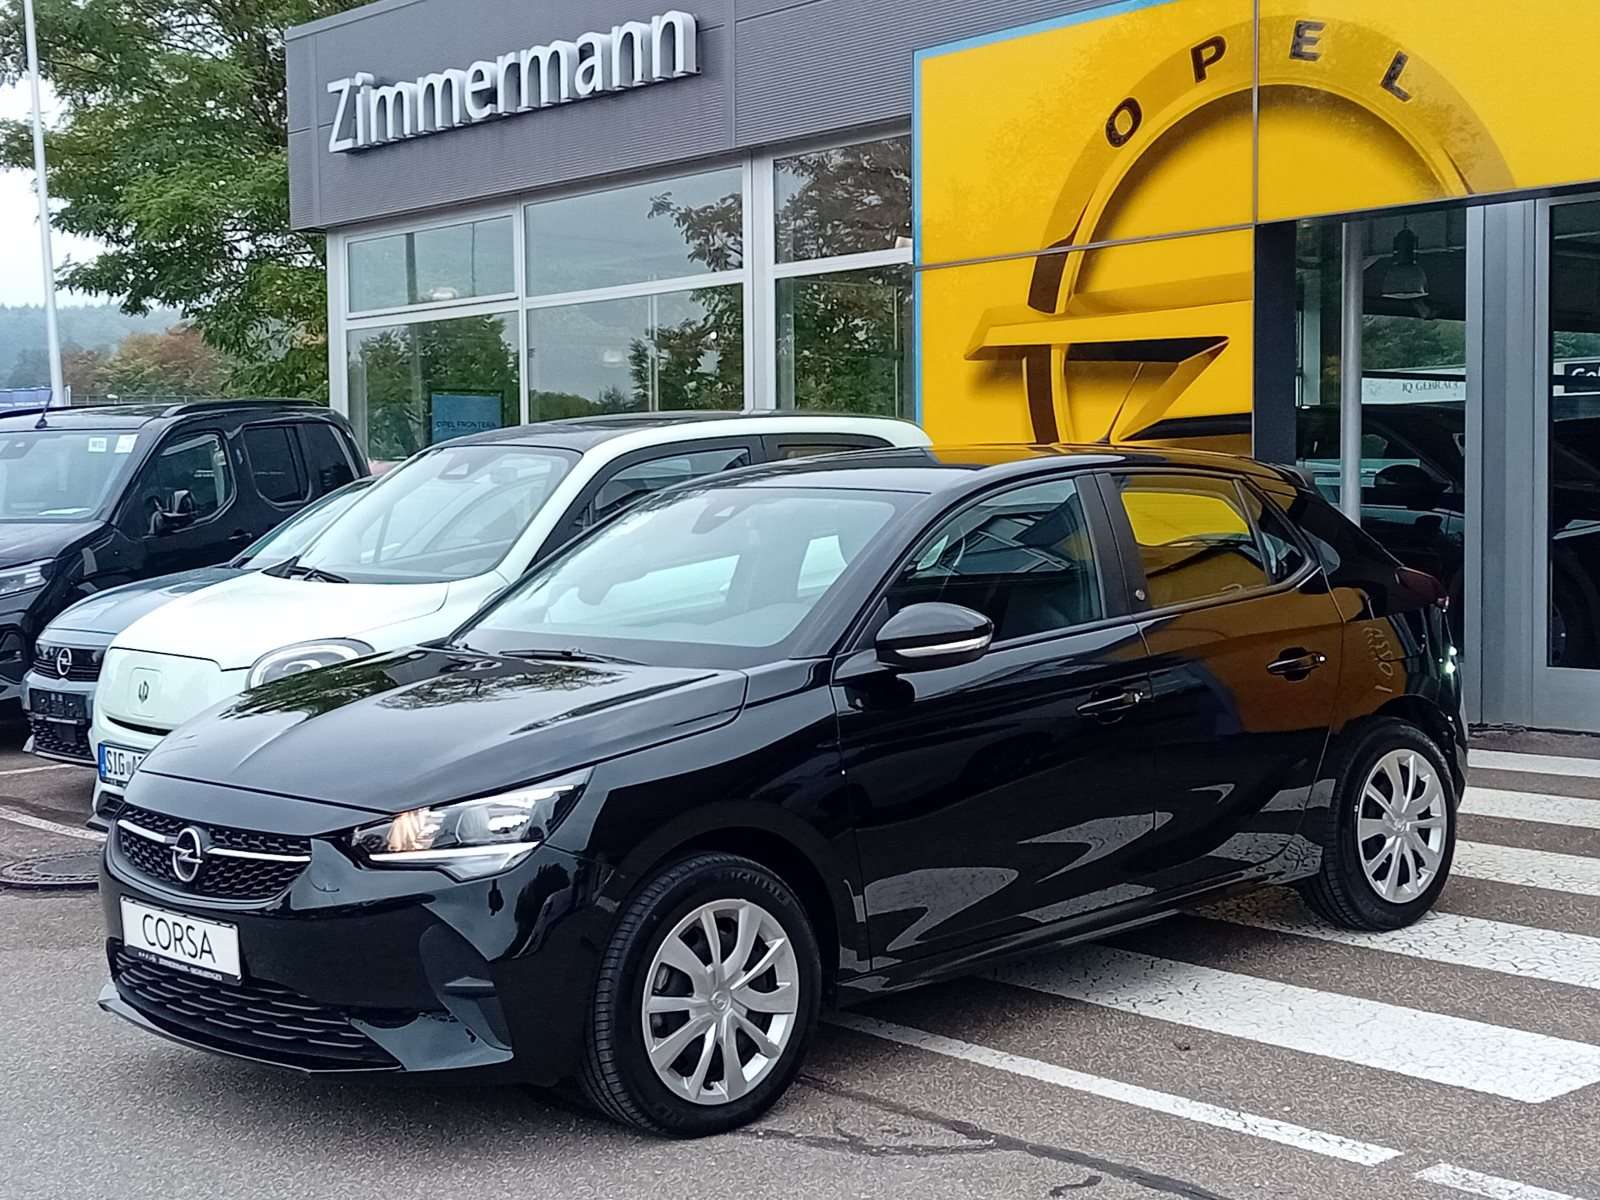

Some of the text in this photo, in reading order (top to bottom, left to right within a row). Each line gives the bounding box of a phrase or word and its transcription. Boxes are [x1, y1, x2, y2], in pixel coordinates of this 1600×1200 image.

[327, 10, 700, 154] Zimmermann
[1105, 19, 1413, 148] OPEL
[106, 750, 125, 775] SIG
[142, 913, 216, 964] CORSA
